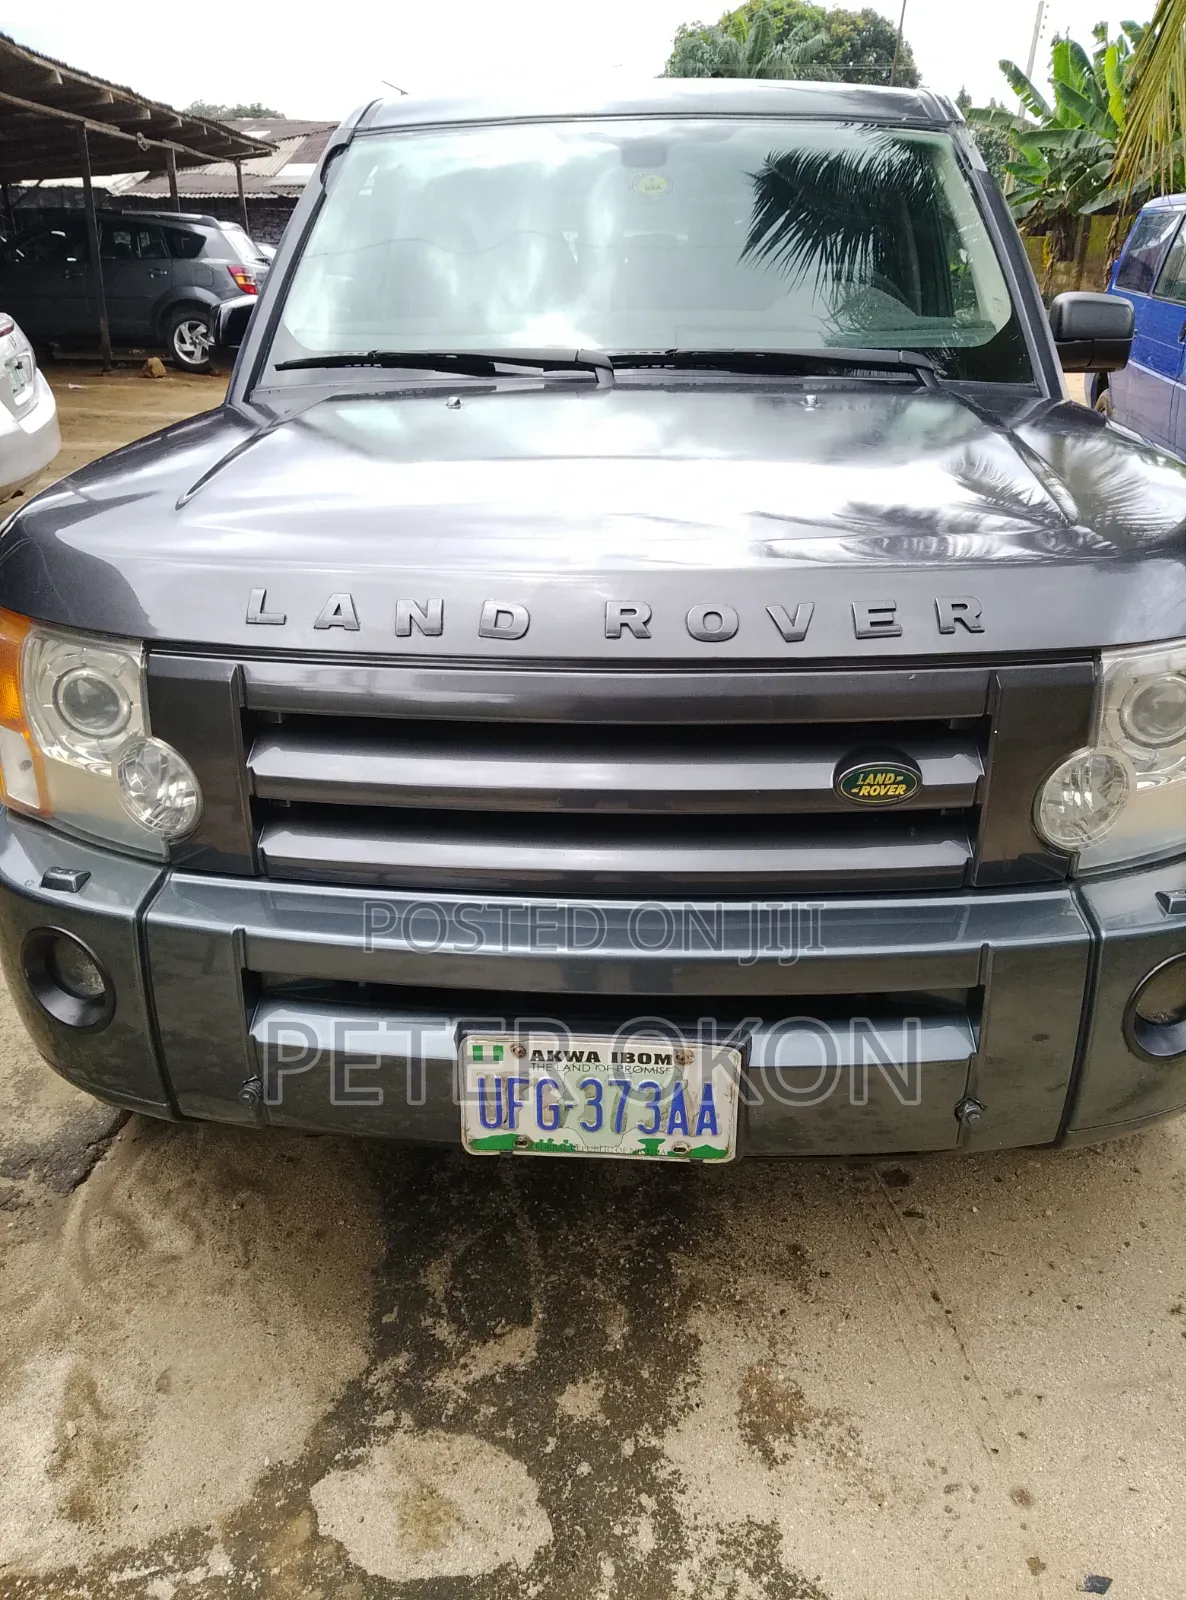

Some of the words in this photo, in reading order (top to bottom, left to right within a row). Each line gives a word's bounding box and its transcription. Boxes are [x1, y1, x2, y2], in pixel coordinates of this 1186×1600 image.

[246, 588, 531, 640] LAND
[604, 595, 985, 642] ROVER
[530, 1049, 600, 1063] AKWA
[611, 1051, 673, 1066] IBOM
[531, 1062, 552, 1072] THE
[556, 1063, 591, 1073] LAND
[595, 1065, 613, 1073] OF
[616, 1065, 673, 1075] PROMISE
[478, 1076, 718, 1137] UFG-373AA
